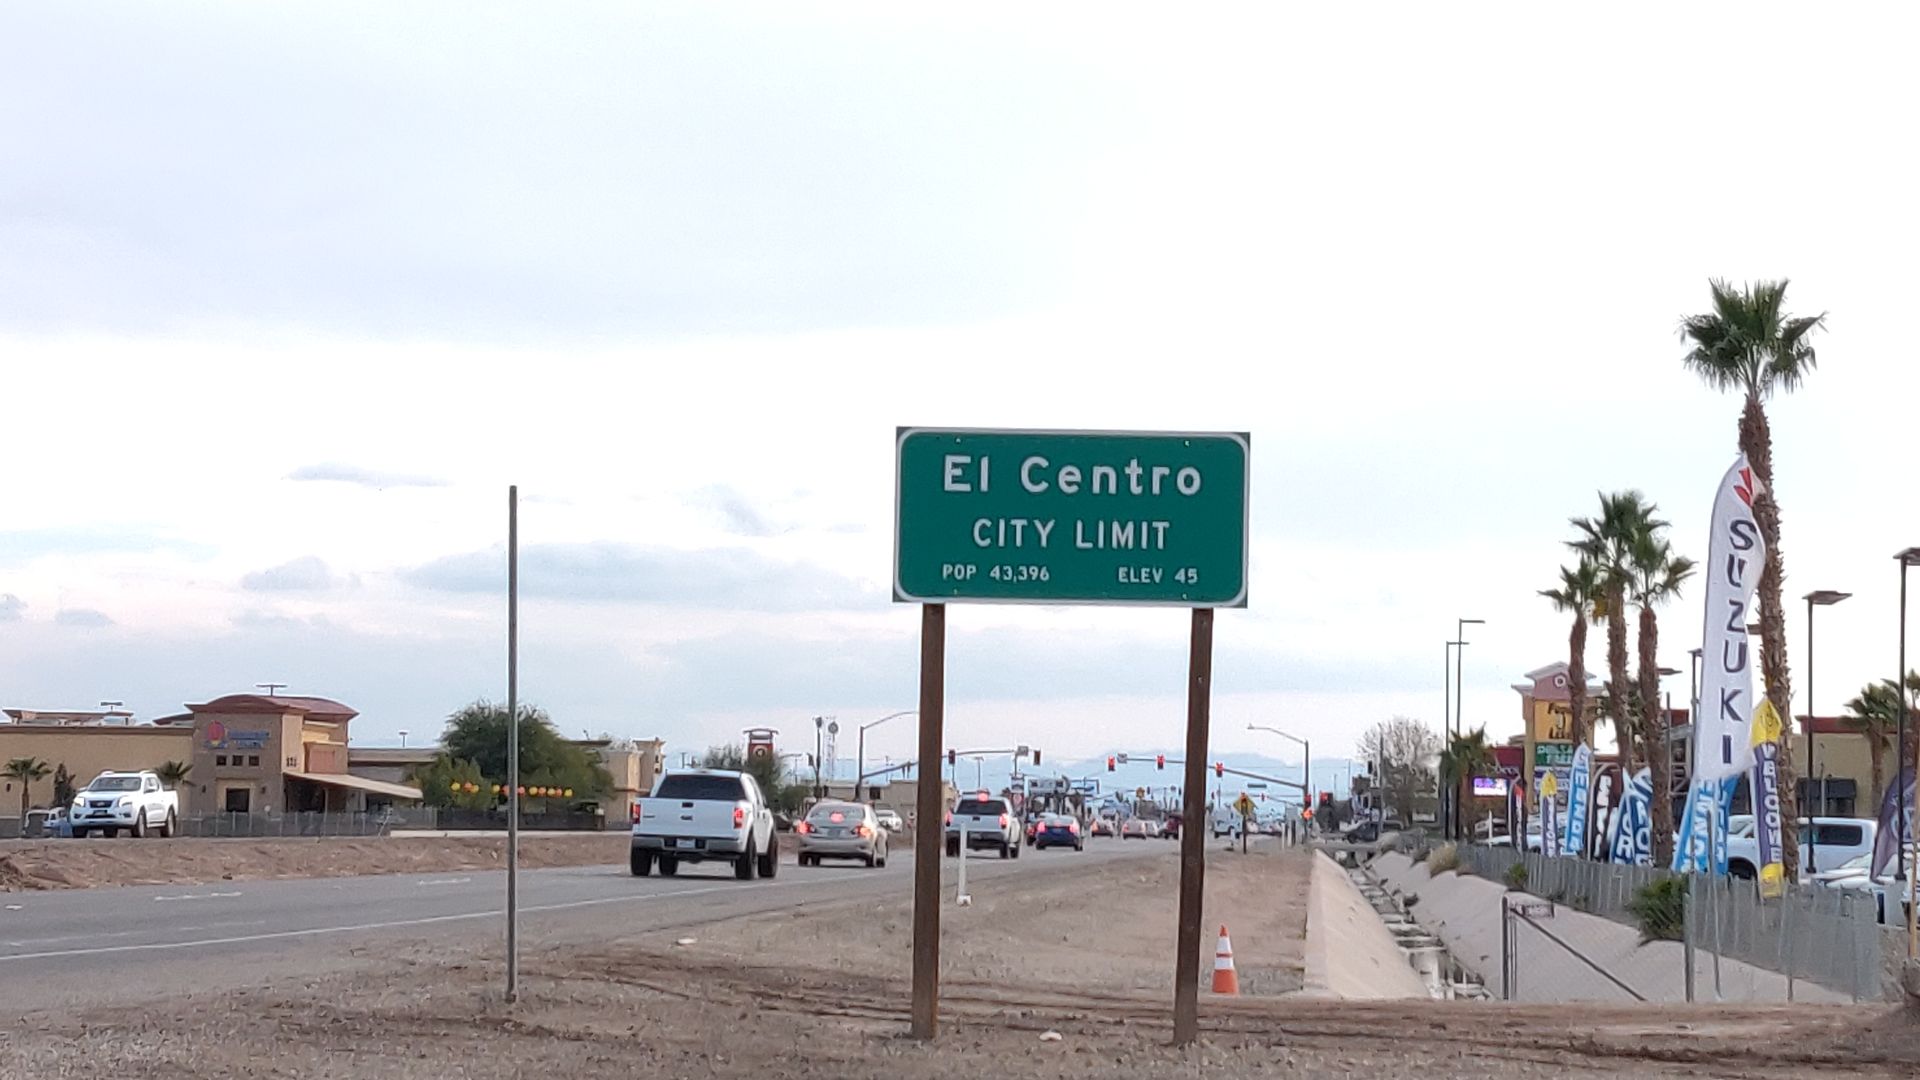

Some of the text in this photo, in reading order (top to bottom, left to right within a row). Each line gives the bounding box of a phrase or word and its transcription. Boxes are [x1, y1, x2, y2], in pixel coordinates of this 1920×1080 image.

[945, 455, 1200, 495] El Centro
[974, 519, 1169, 548] CITY LIMIT
[943, 565, 1197, 583] POP 43,396 ELEV 45
[1720, 519, 1757, 765] SUZUKI
